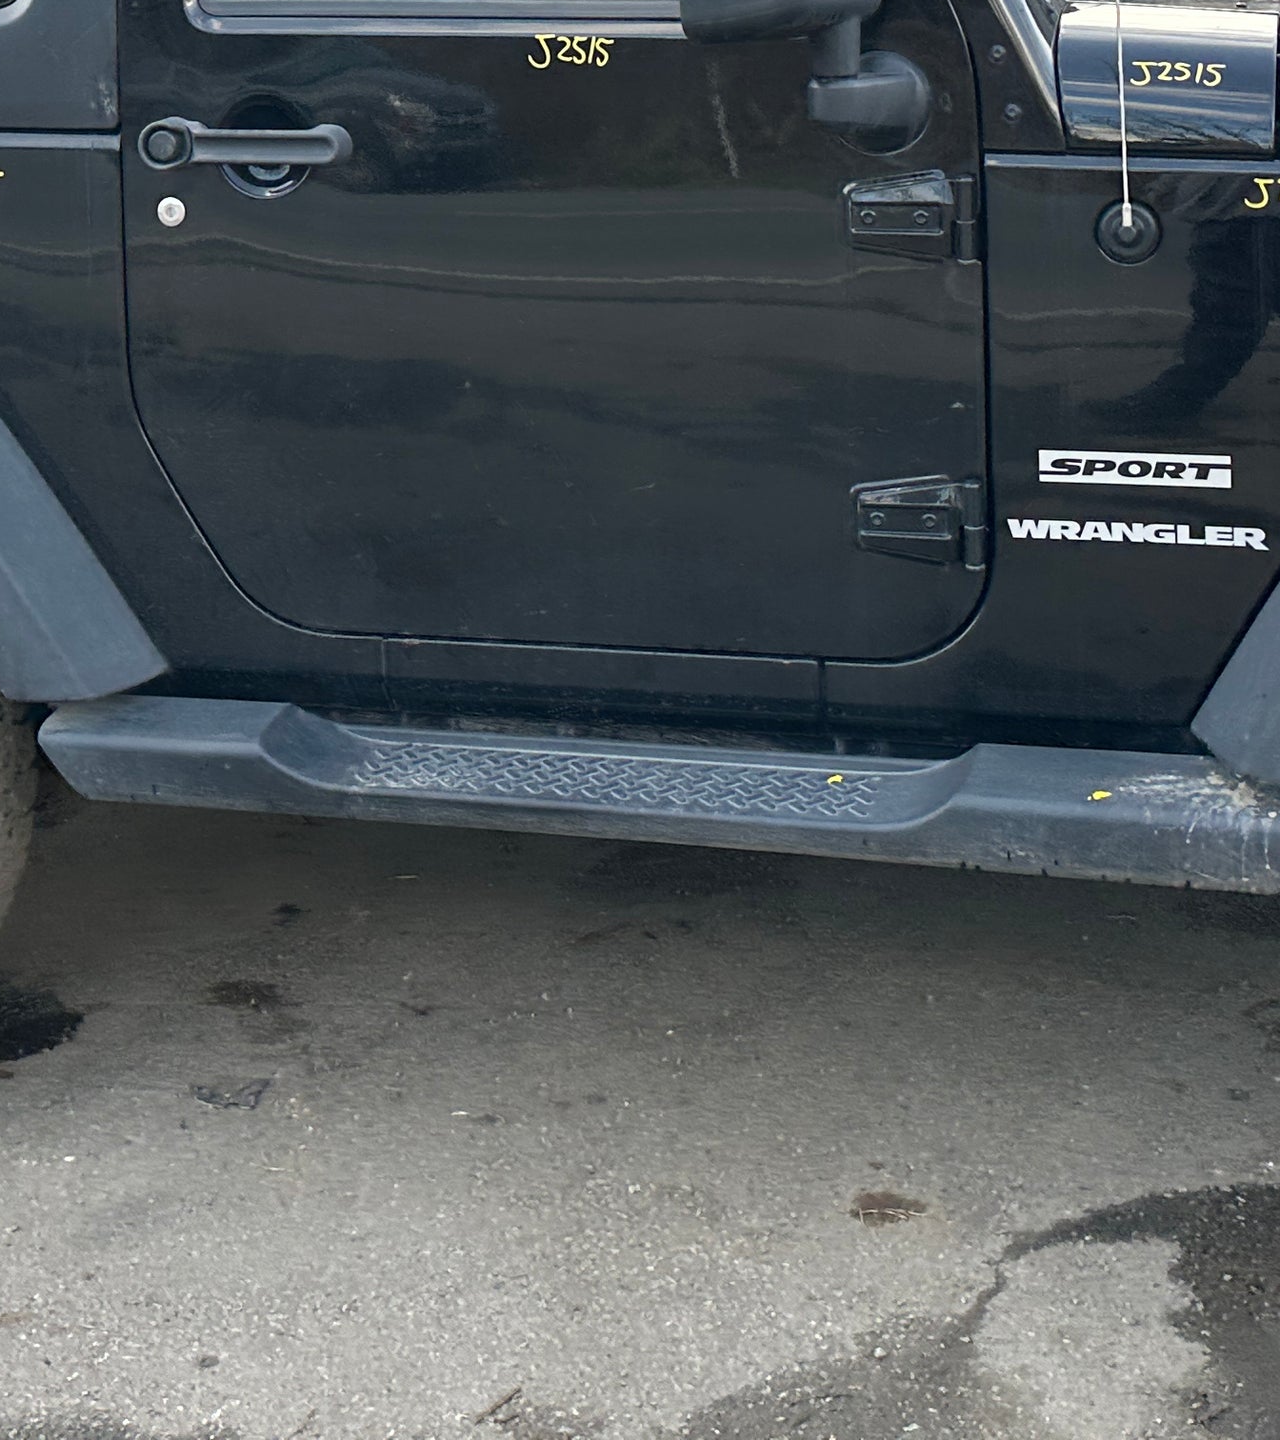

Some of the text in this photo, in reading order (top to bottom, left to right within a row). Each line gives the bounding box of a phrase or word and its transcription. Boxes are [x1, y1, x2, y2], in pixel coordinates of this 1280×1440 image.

[527, 33, 615, 69] J2515
[1130, 61, 1226, 87] J2515
[1051, 458, 1215, 480] SPORT
[1006, 518, 1270, 551] WRANGLER
